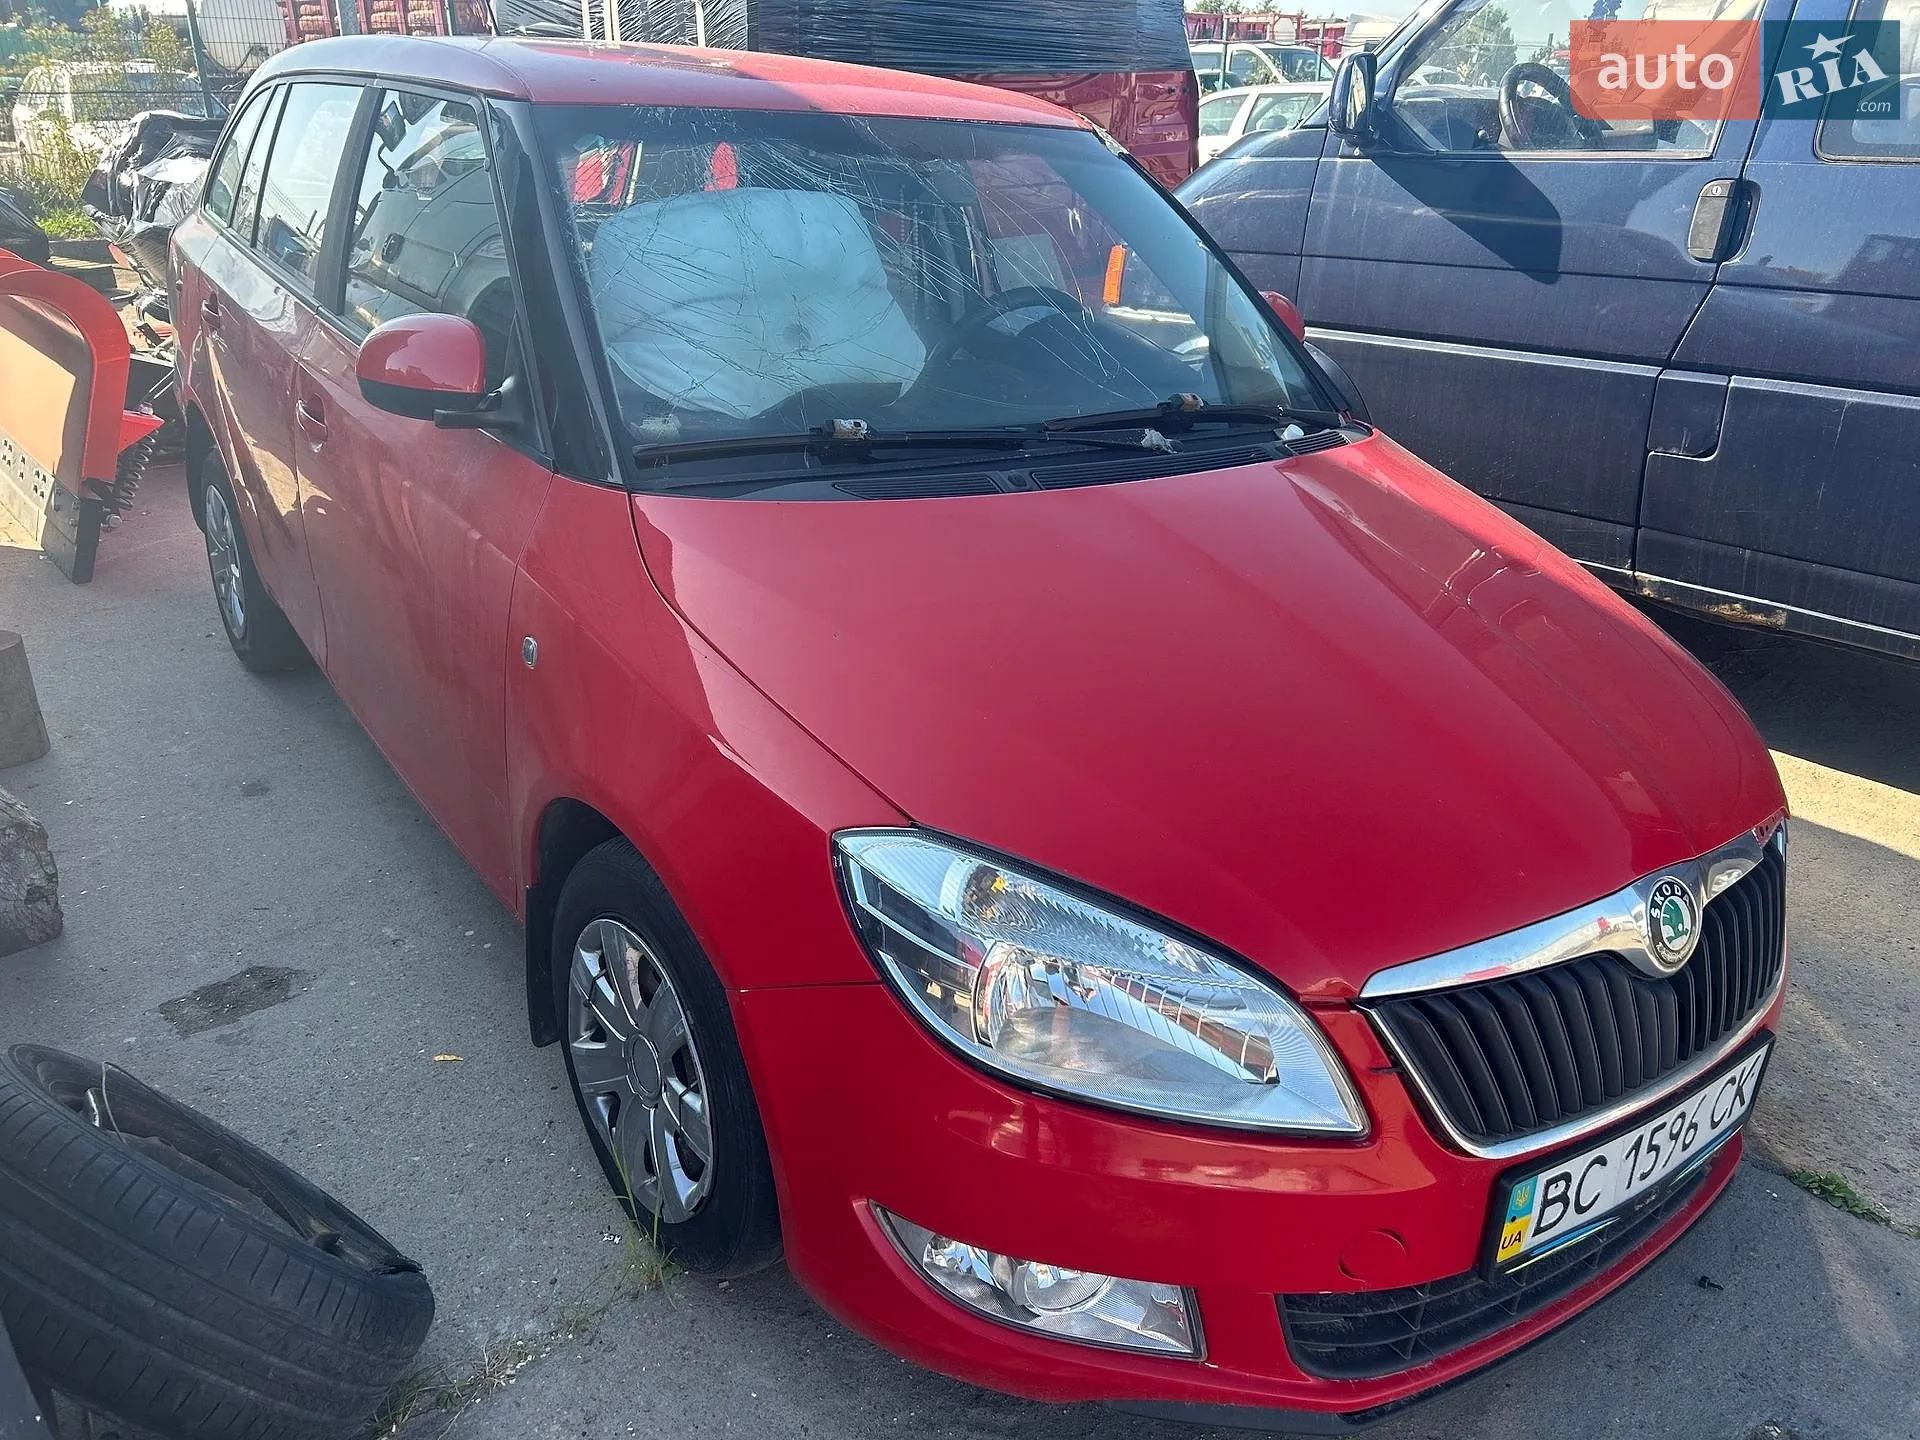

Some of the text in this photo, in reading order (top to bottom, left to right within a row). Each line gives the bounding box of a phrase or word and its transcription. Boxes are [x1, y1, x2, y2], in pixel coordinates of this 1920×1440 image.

[1532, 1054, 1761, 1237] BC 1596 CK
[1501, 1230, 1522, 1250] UA
